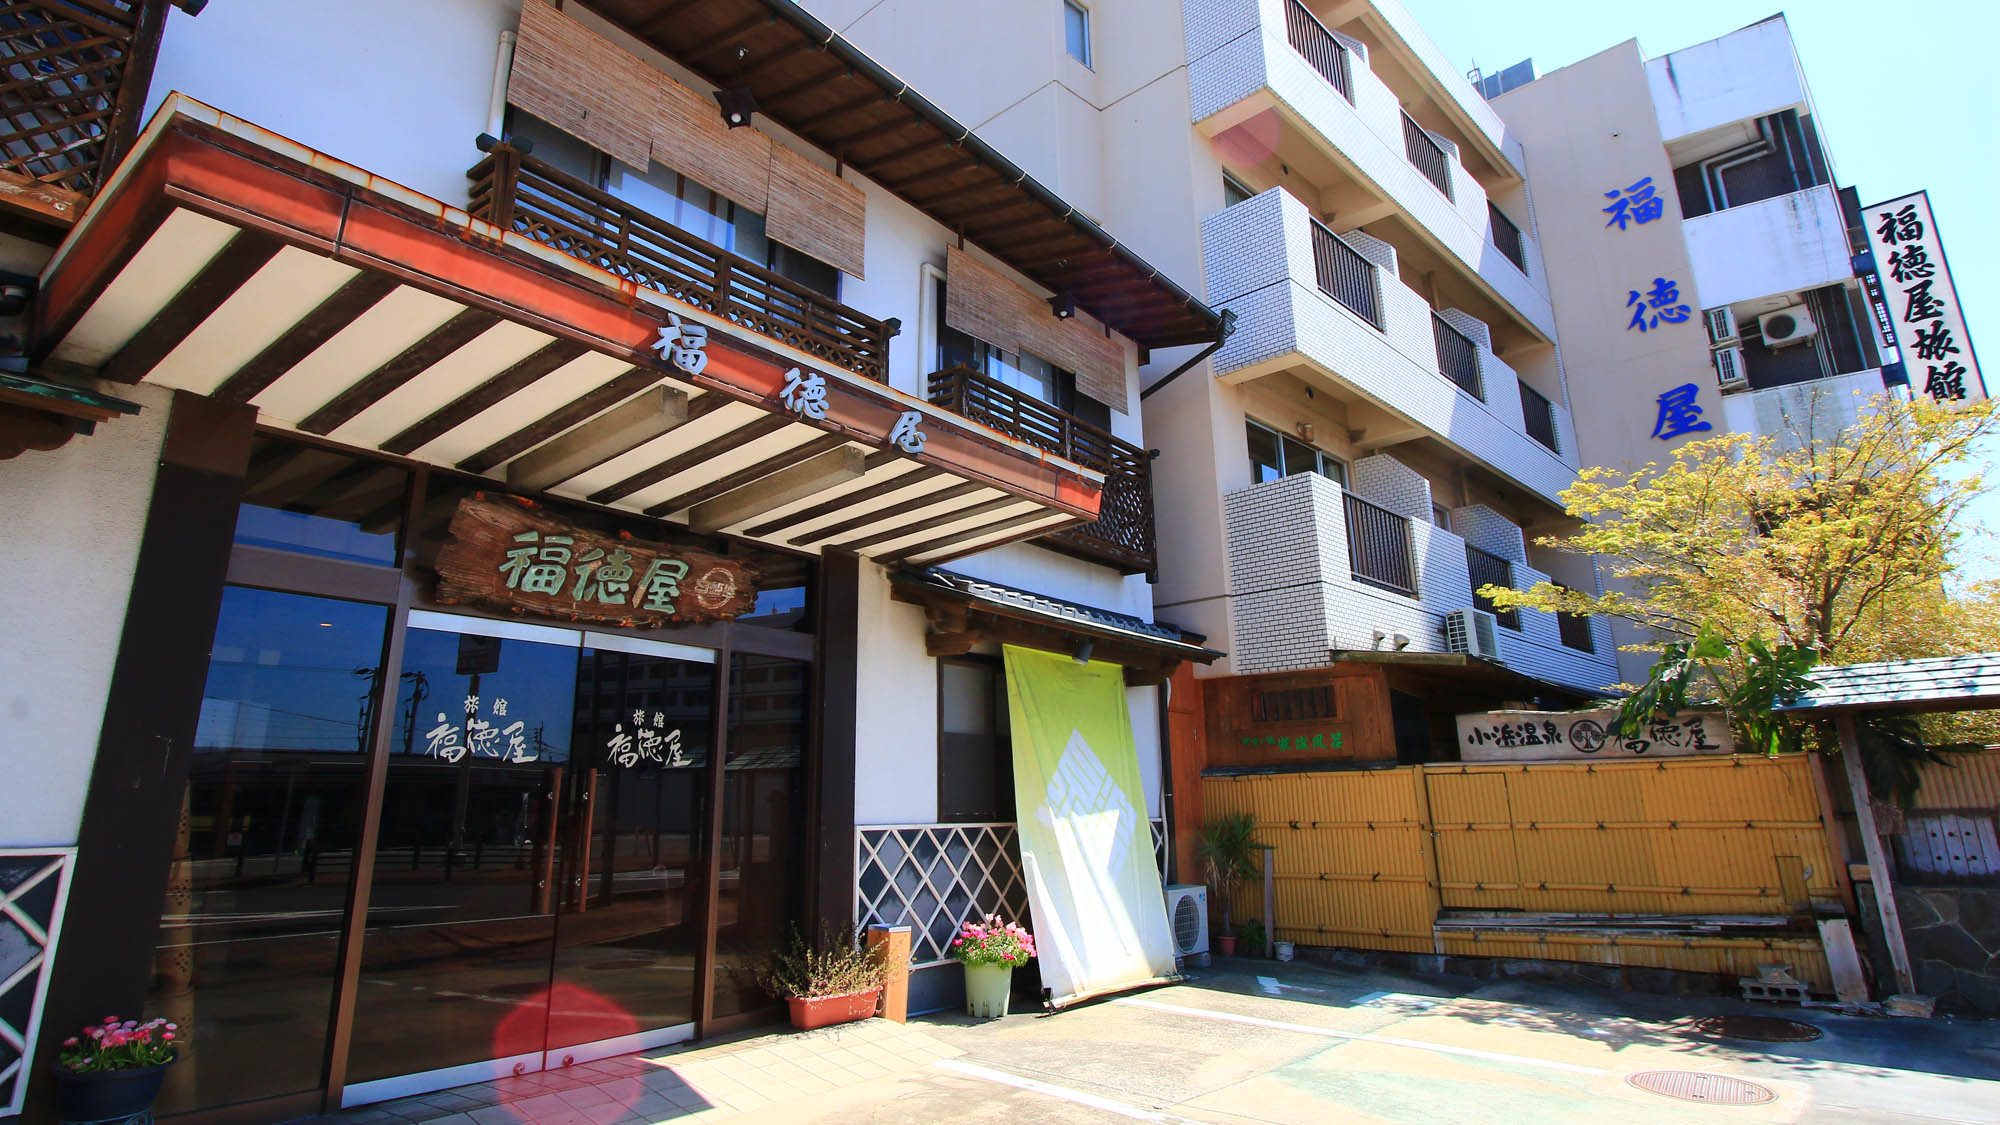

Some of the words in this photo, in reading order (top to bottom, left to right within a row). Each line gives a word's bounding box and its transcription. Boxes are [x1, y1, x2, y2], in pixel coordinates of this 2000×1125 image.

[1602, 177, 1713, 441] 福徳屋
[1876, 203, 1967, 404] 福徳屋旅館
[650, 312, 928, 454] 福徳屋
[499, 531, 689, 614] 福徳屋
[464, 695, 508, 717] 旅館
[632, 709, 665, 728] 旅館
[424, 712, 539, 763] 福徳屋
[607, 723, 692, 768] 福徳屋
[1468, 719, 1562, 747] 小浜温泉
